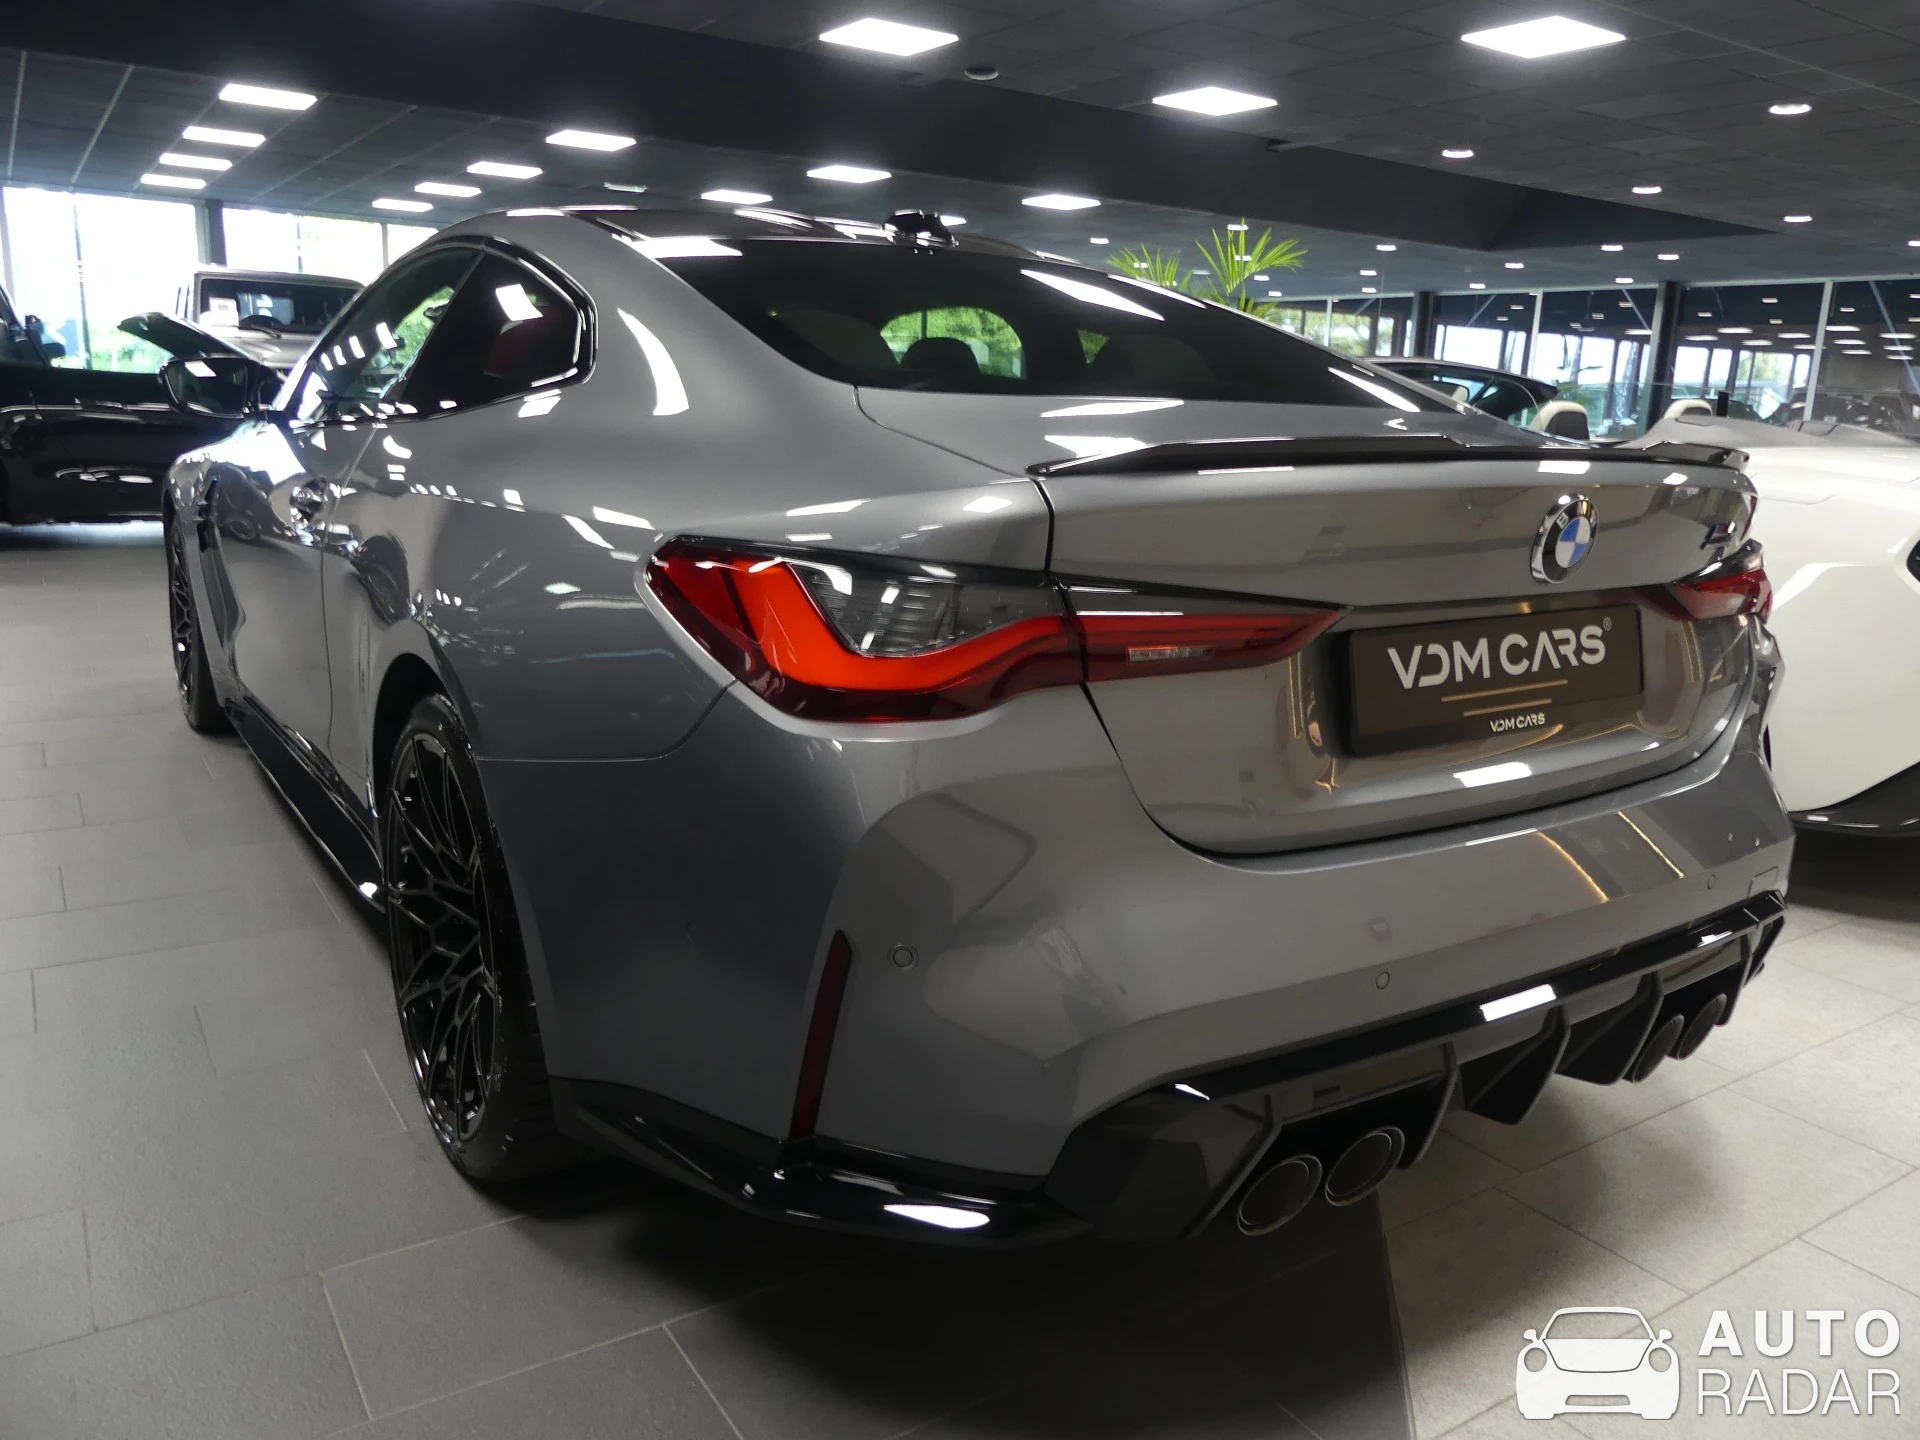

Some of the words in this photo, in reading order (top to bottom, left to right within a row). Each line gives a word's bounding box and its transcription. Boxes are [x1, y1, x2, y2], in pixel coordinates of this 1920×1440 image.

[1387, 637, 1491, 689] VDM
[1490, 717, 1515, 732] VDM
[1516, 712, 1546, 728] CARS
